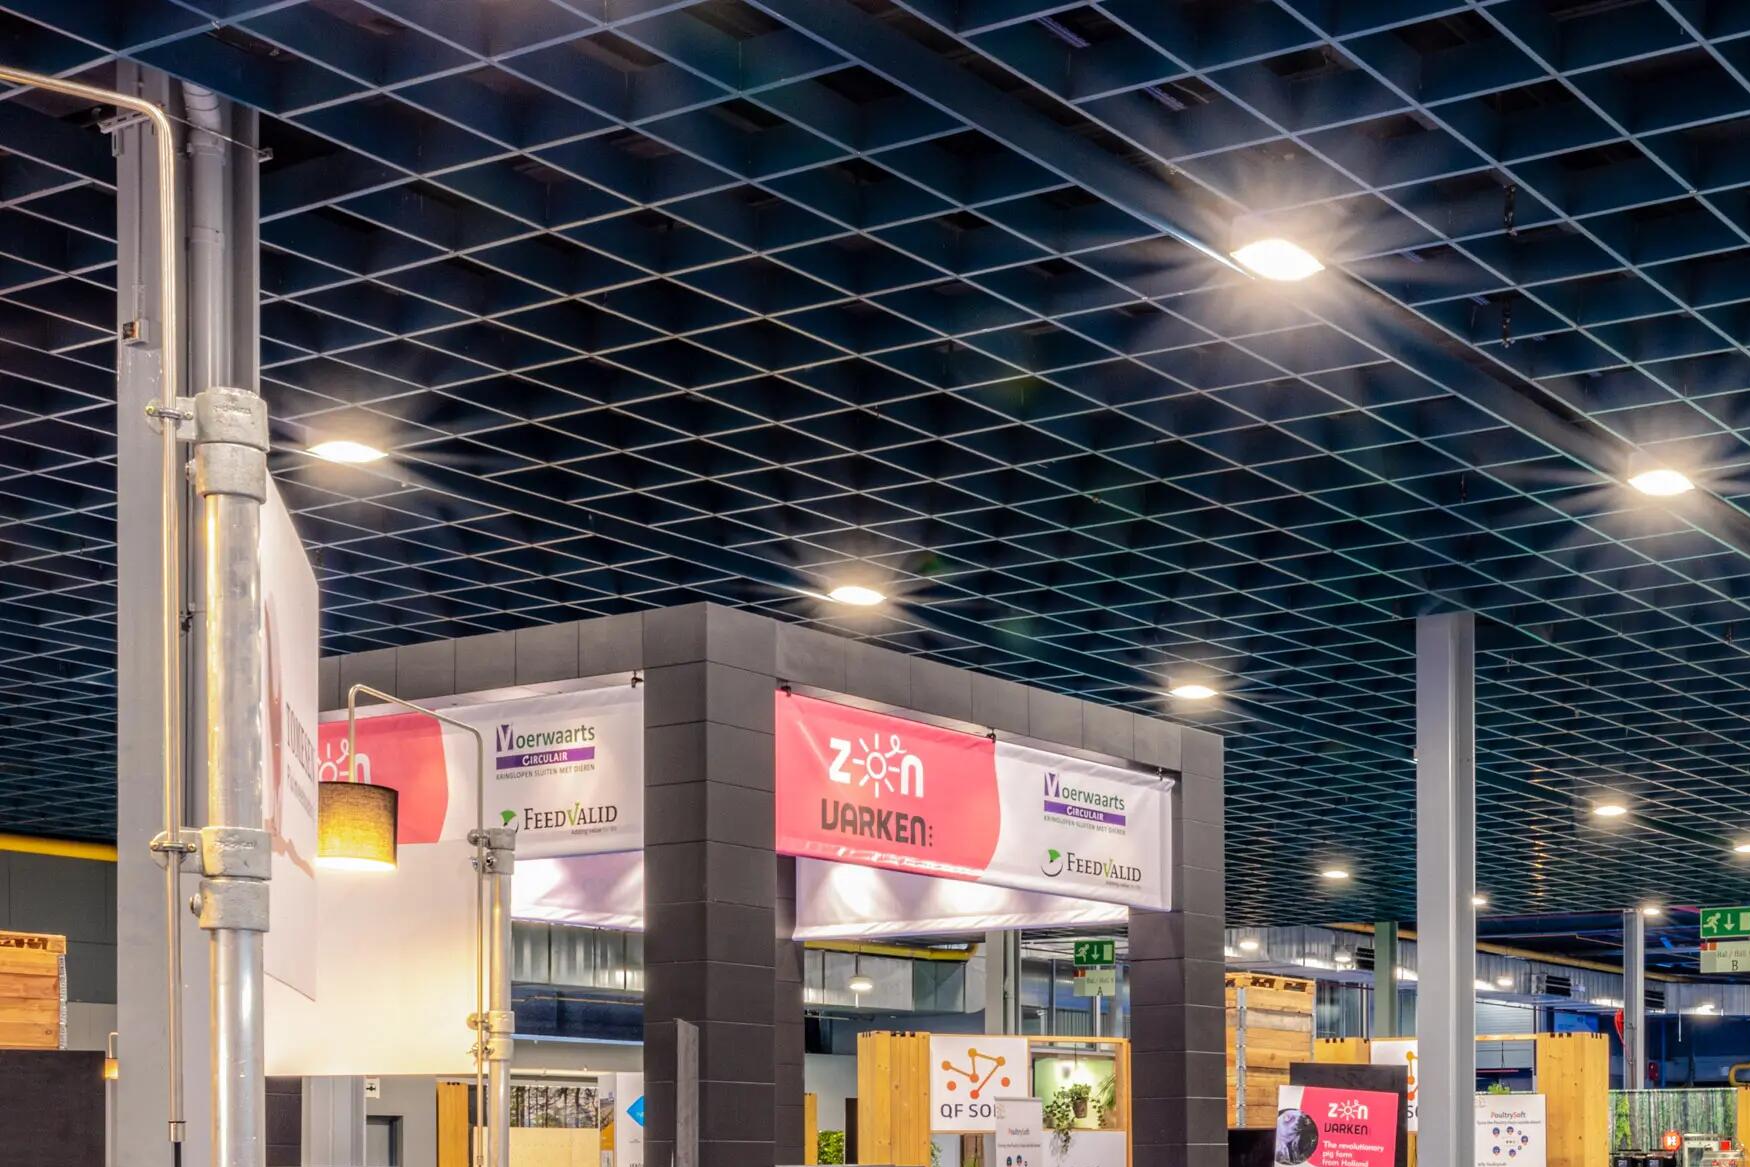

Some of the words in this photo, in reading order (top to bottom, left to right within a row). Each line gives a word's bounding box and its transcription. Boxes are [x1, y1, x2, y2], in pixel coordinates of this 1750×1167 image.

[496, 724, 595, 752] Voerwaarts
[522, 752, 568, 766] CIRCULAIR
[1044, 772, 1125, 810] Voerwaarts
[1066, 806, 1104, 821] CIRCULAIR
[1731, 960, 1739, 971] B
[940, 1103, 964, 1119] QF
[1490, 1111, 1526, 1119] PoultrySoft
[1322, 1139, 1338, 1149] The
[1338, 1142, 1385, 1153] revolutionary
[1322, 1150, 1334, 1159] pig
[1335, 1150, 1353, 1158] farm
[1321, 1159, 1339, 1167] from
[1340, 1160, 1369, 1167] Holland
